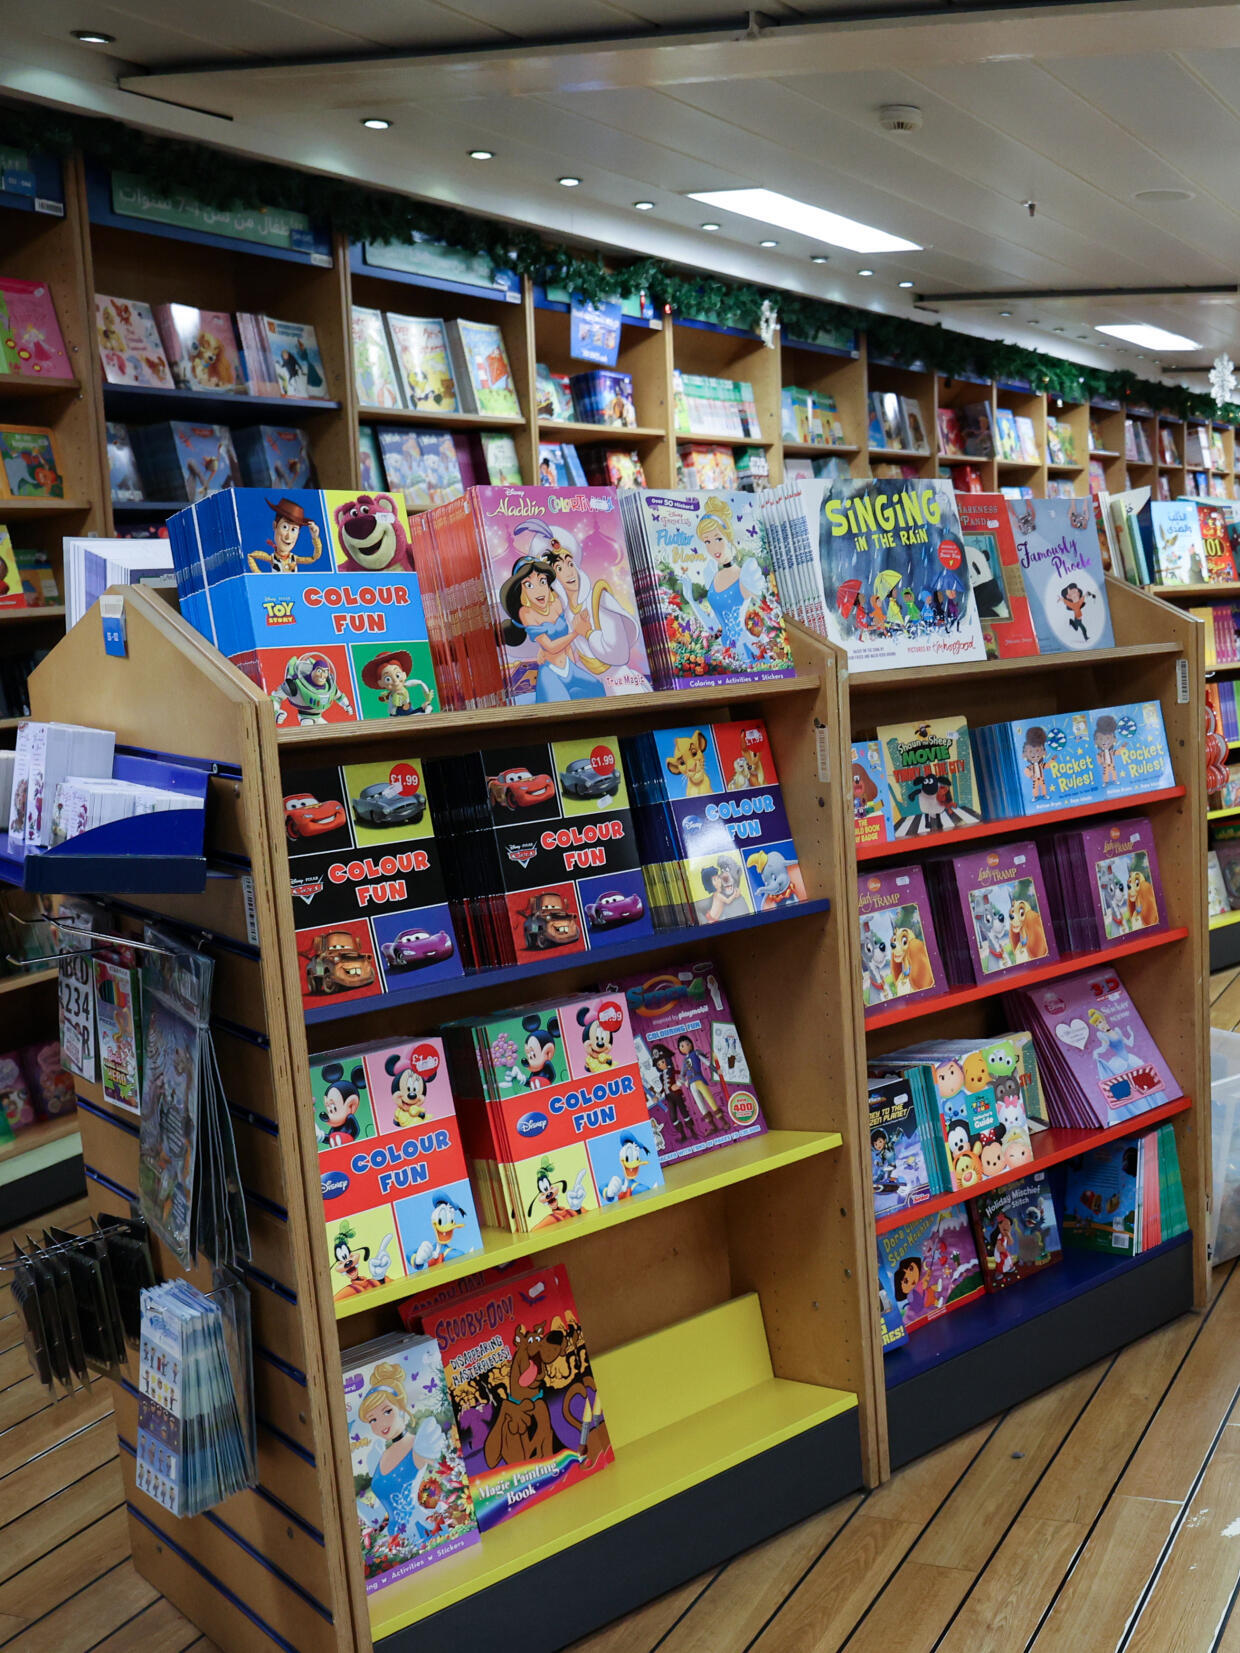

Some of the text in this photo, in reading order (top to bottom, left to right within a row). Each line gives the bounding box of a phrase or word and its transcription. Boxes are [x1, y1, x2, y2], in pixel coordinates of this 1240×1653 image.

[504, 487, 525, 498] Disney
[664, 499, 674, 507] 50
[487, 496, 546, 518] Aladdin
[872, 534, 897, 549] THE
[1016, 535, 1078, 570] Famously
[1051, 554, 1093, 578] Phoebe
[303, 585, 411, 607] COLOUR
[263, 601, 294, 617] TOY
[268, 616, 294, 624] STORY
[332, 612, 387, 634] FUN
[624, 674, 646, 685] Magic
[689, 679, 715, 687] Coloring
[725, 676, 752, 684] Activities
[590, 753, 615, 768] £1.99
[902, 745, 950, 767] MOVIE
[1121, 744, 1164, 764] Rocket
[1050, 756, 1094, 778] Rocket
[1128, 758, 1164, 778] Rules!
[1058, 770, 1095, 792] Rules!
[704, 795, 775, 821] COLOUR
[540, 820, 625, 850] COLOUR
[727, 819, 762, 840] FUN
[862, 833, 879, 842] BADGE
[865, 825, 880, 834] BOOK
[328, 850, 431, 884] COLOUR
[563, 846, 606, 872] FUN
[992, 867, 1018, 882] TRAMP
[356, 880, 408, 907] FUN
[872, 893, 900, 908] TRAMP
[678, 1005, 709, 1020] playmobil
[646, 1024, 686, 1041] COLOURING
[686, 1020, 702, 1032] FUN
[549, 1075, 635, 1115] COLOUR
[734, 1102, 753, 1112] 400
[883, 1108, 908, 1122] PLANET
[891, 1103, 904, 1112] THE
[520, 1117, 548, 1133] Disney
[573, 1105, 616, 1134] FUN
[974, 1117, 994, 1129] Guide
[351, 1130, 452, 1174] COLOUR
[321, 1178, 349, 1193] Disney
[379, 1162, 429, 1196] FUN
[985, 1193, 1012, 1217] Holiday
[1011, 1184, 1041, 1200] Mischief
[1011, 1197, 1030, 1209] Stitch
[883, 1230, 905, 1253] Dora
[887, 1242, 908, 1267] Star
[435, 1295, 516, 1351] SCOOBY-DOO!
[450, 1335, 504, 1370] DISAPPEARING
[452, 1346, 512, 1387] MASTERPIECES!
[478, 1460, 561, 1501] Magic Painting
[505, 1484, 537, 1506] Book
[391, 1559, 425, 1580] Activities
[436, 1540, 465, 1558] Stickers
